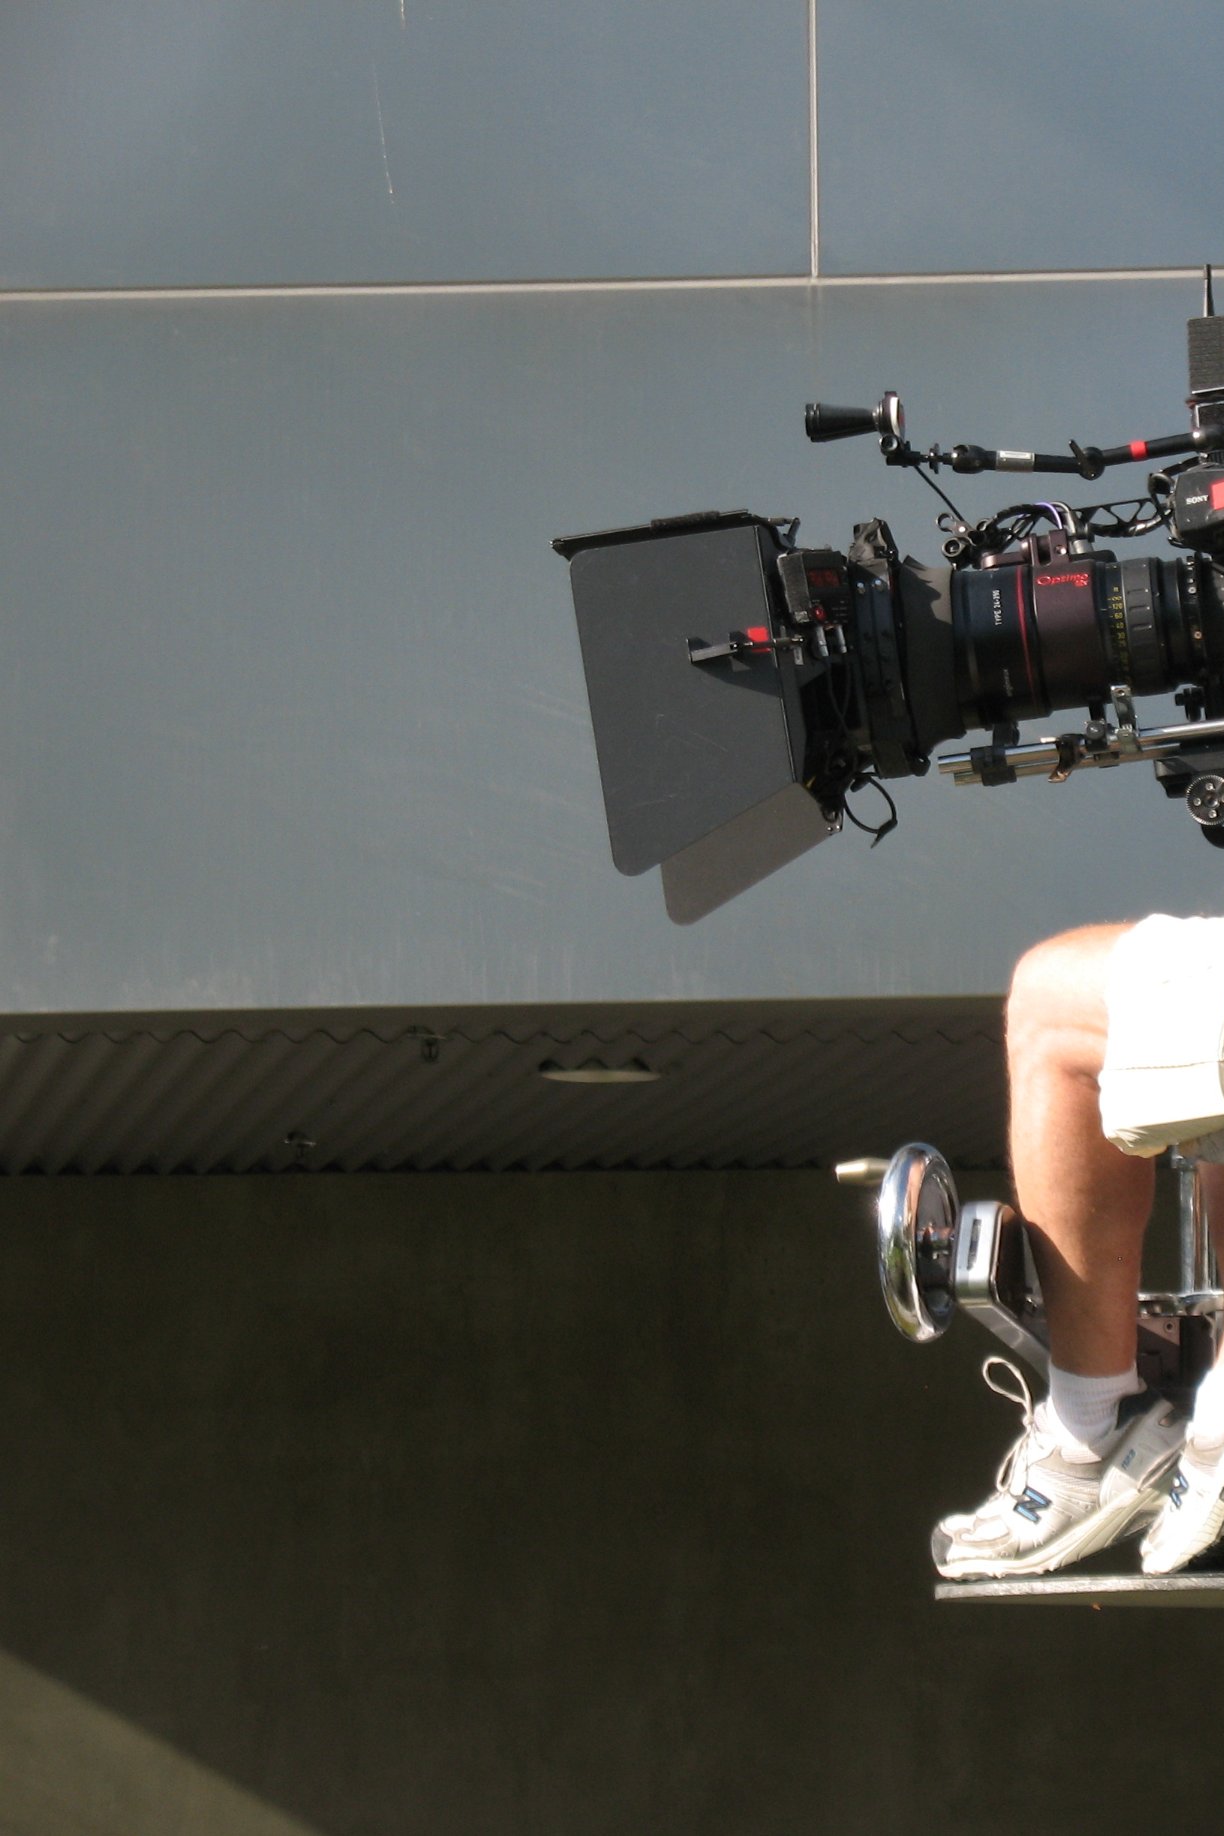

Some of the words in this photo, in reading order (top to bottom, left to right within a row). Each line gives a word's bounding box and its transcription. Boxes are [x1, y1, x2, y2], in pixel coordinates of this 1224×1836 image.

[1186, 495, 1209, 505] SONY
[993, 609, 1002, 625] TYPE
[1013, 1485, 1052, 1524] N
